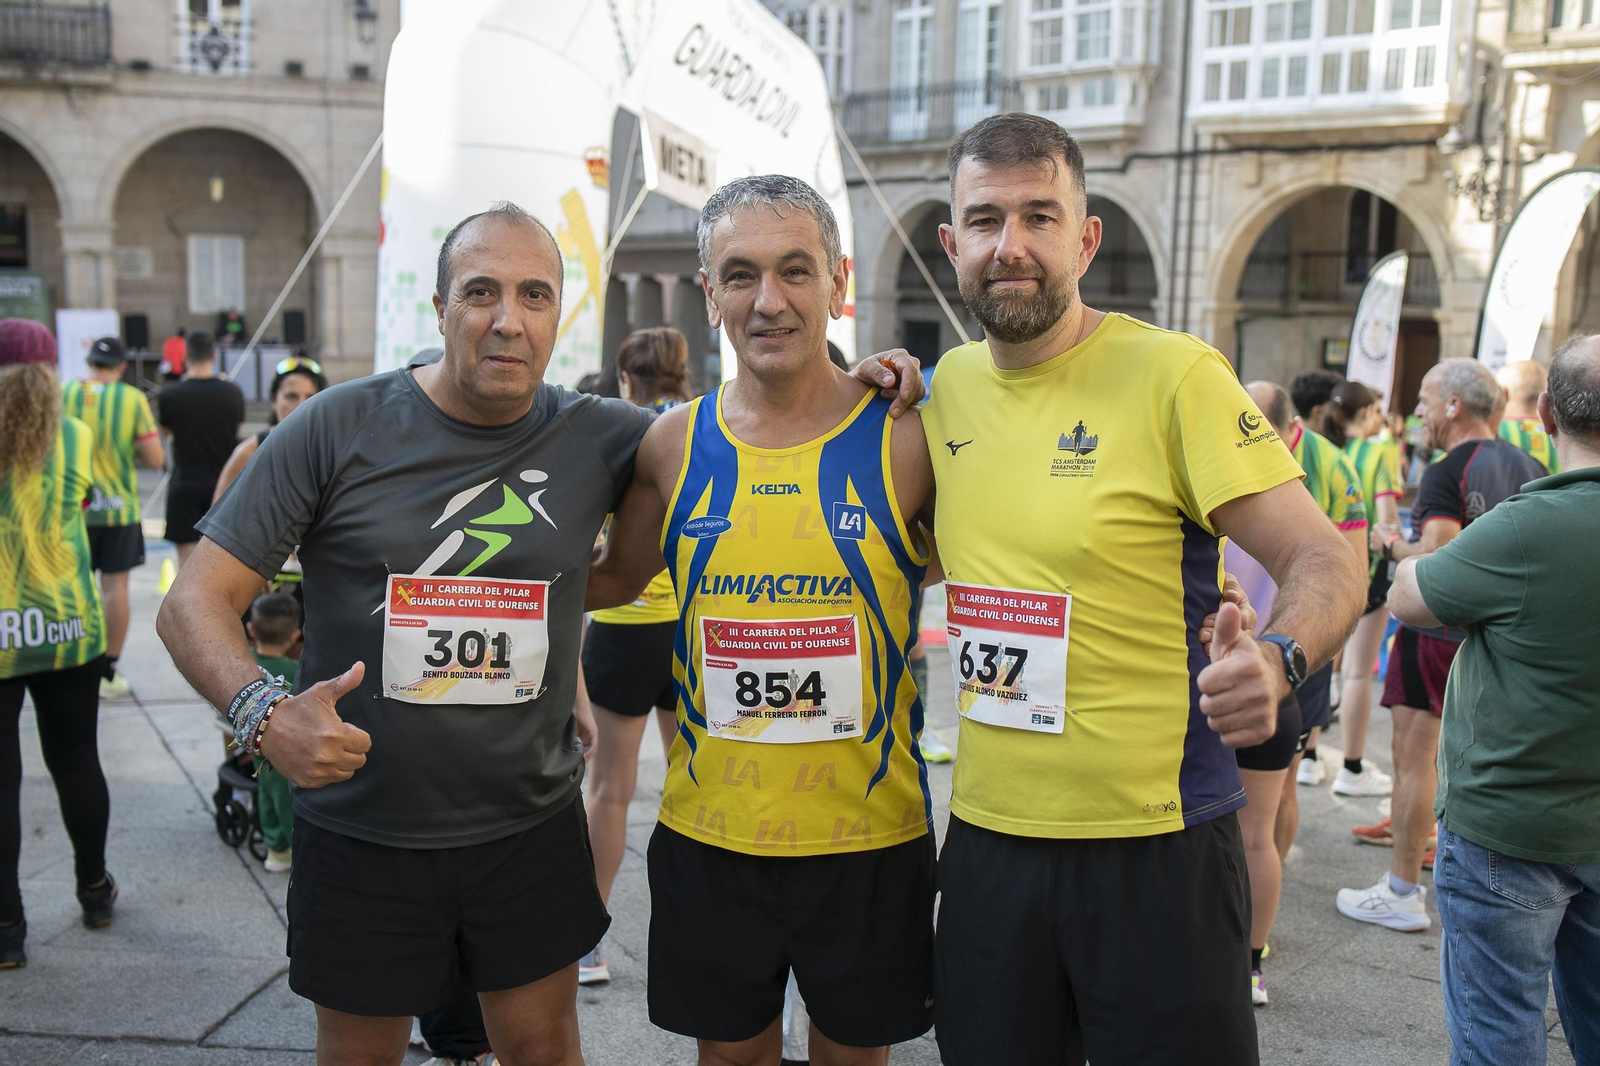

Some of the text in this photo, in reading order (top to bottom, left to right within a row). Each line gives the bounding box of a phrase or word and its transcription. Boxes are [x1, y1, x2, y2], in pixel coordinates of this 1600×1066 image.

[674, 23, 767, 113] GUARDIA
[659, 133, 708, 187] META
[751, 483, 802, 495] KELTIA
[838, 511, 862, 532] LA
[423, 584, 530, 598] III CARRERA DEL PILAR
[699, 574, 852, 603] LIMIACTIVA
[410, 597, 539, 610] GUARDIA CIVIL DE OURENSE
[966, 593, 1001, 606] CARRERA
[1004, 598, 1019, 608] DEL
[1021, 600, 1048, 611] PILAR
[954, 605, 1060, 627] GUARDIA CIVIL DE OURENSE
[46, 616, 86, 644] CIVIL
[729, 626, 838, 638] III CARRERA DEL PILAR
[424, 630, 511, 669] 301
[720, 638, 850, 650] GUARDIA CIVIL DE OURENSE
[960, 641, 1028, 687] 637
[422, 670, 511, 680] BENITO BOUZADA BLANCO
[736, 670, 826, 708] 854
[975, 686, 995, 696] ALONSO
[996, 690, 1028, 701] VAZQUEZ
[737, 709, 826, 718] MANUEL FERREIRO FERRON
